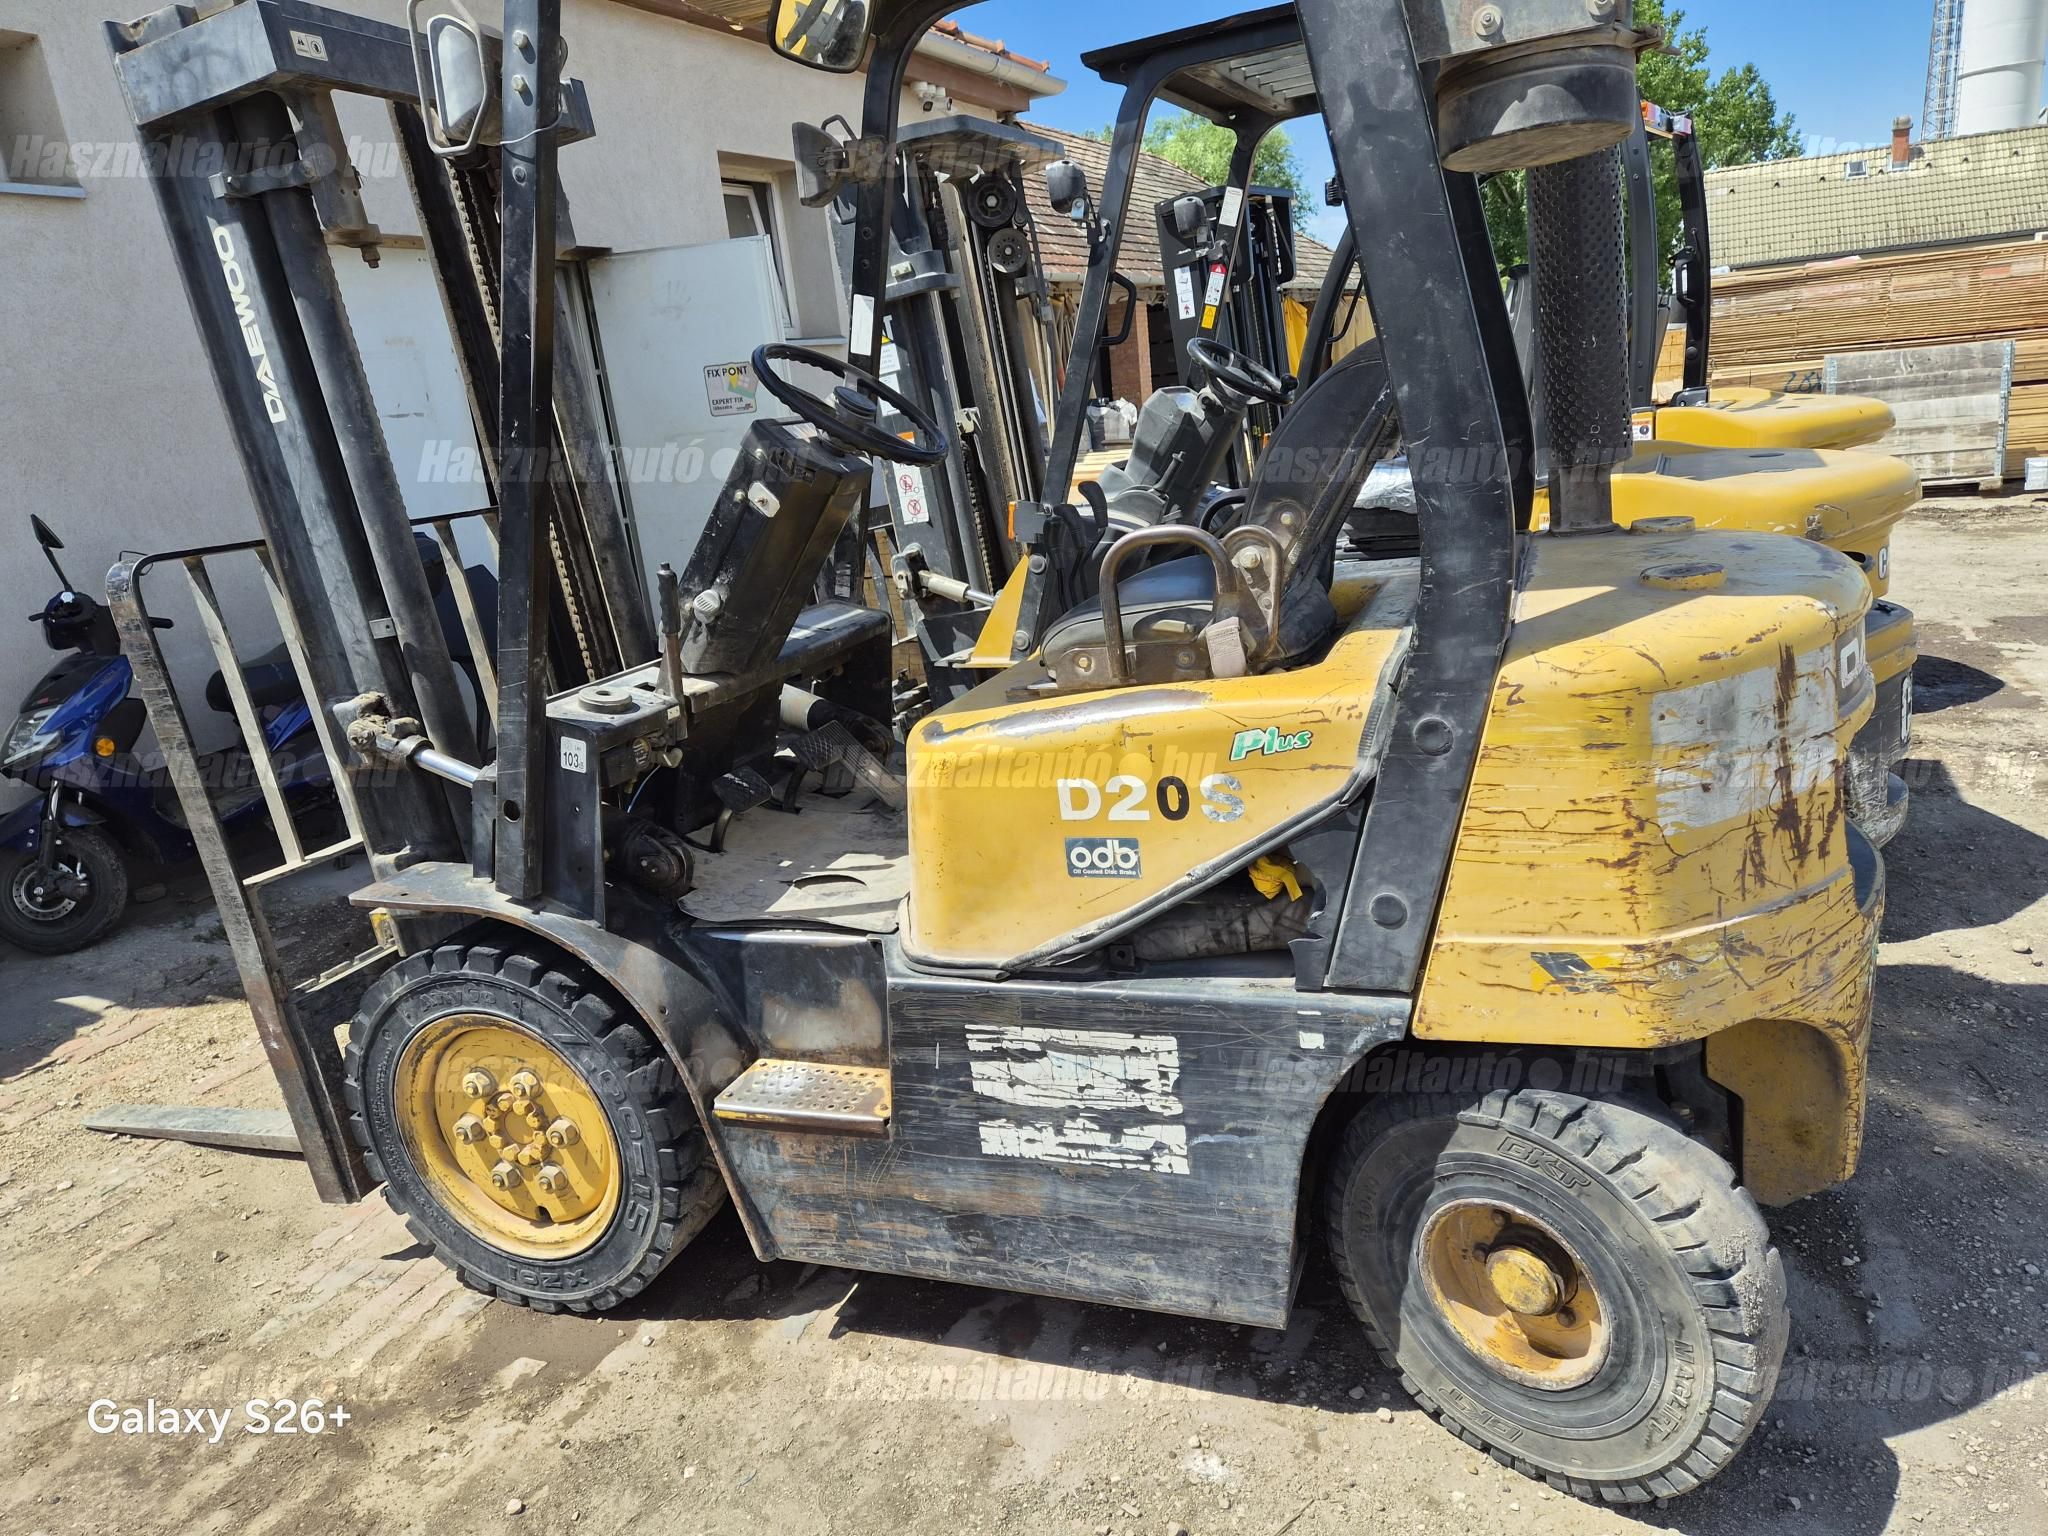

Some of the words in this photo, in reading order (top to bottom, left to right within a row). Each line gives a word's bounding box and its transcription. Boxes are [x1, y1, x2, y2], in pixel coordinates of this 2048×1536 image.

[209, 225, 287, 424] DAEWOO
[706, 368, 721, 379] FIX
[721, 365, 748, 377] PONT
[711, 397, 733, 406] EXPERT
[563, 751, 579, 768] 103
[1230, 726, 1314, 761] Plus
[1056, 773, 1245, 823] D20S
[1069, 839, 1139, 869] odb
[1495, 1134, 1593, 1190] BKT
[1645, 1338, 1696, 1442] MAGLIFT
[1436, 1385, 1524, 1444] BKT
